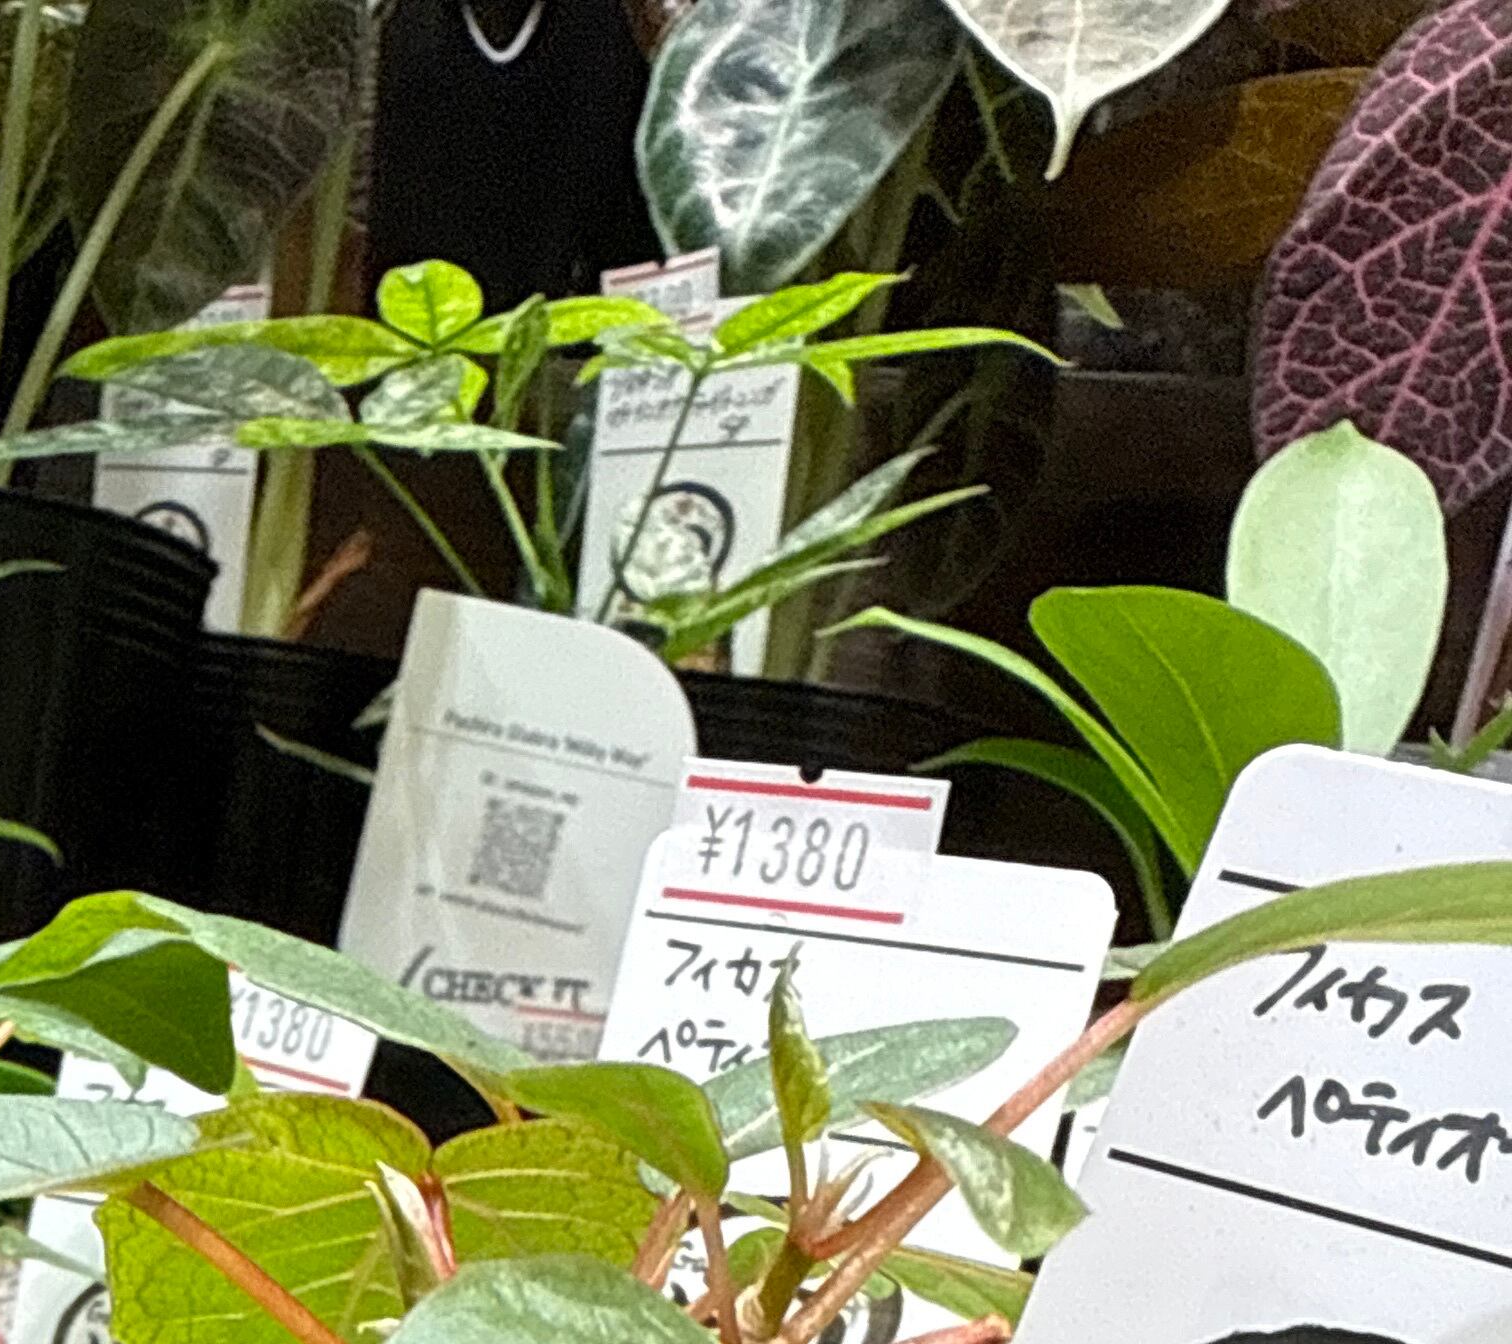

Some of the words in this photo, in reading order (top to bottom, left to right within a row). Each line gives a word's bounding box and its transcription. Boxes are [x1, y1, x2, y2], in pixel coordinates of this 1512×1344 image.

[696, 803, 871, 892] ¥1380
[1252, 943, 1472, 1046] フィカス
[1256, 1074, 1512, 1184] ペティオ
